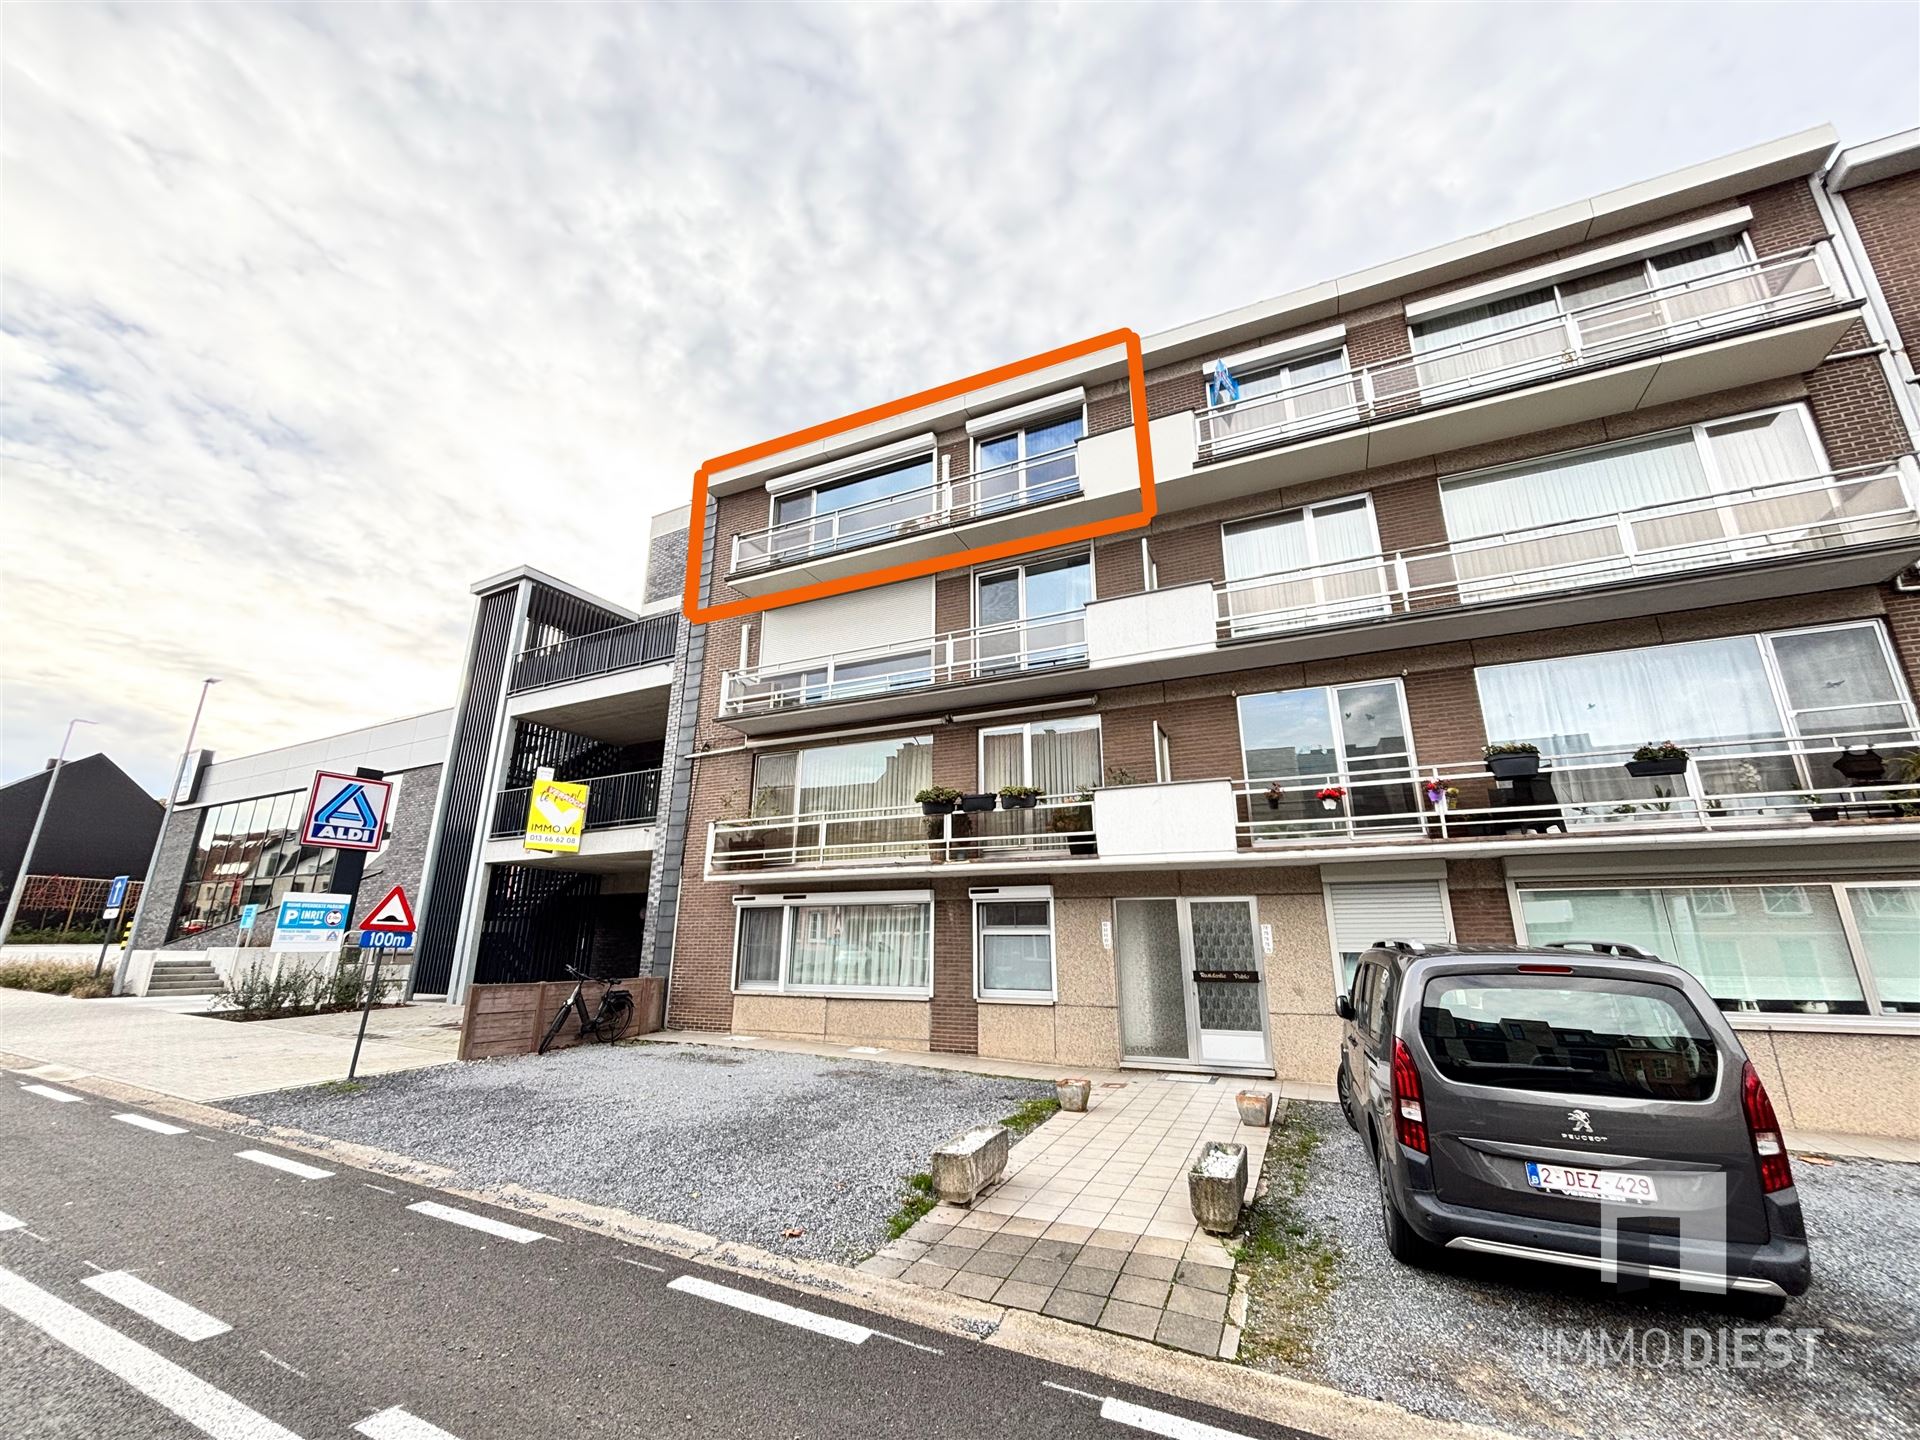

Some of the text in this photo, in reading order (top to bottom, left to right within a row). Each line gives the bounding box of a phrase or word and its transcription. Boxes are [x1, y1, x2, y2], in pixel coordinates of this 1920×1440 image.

[317, 825, 371, 841] ALDI
[531, 823, 577, 835] IMMO VL
[529, 834, 543, 842] 013
[300, 910, 326, 920] INRIT
[370, 931, 406, 947] 100m
[1560, 1133, 1608, 1142] PEUGEOT
[1530, 1175, 1540, 1185] B
